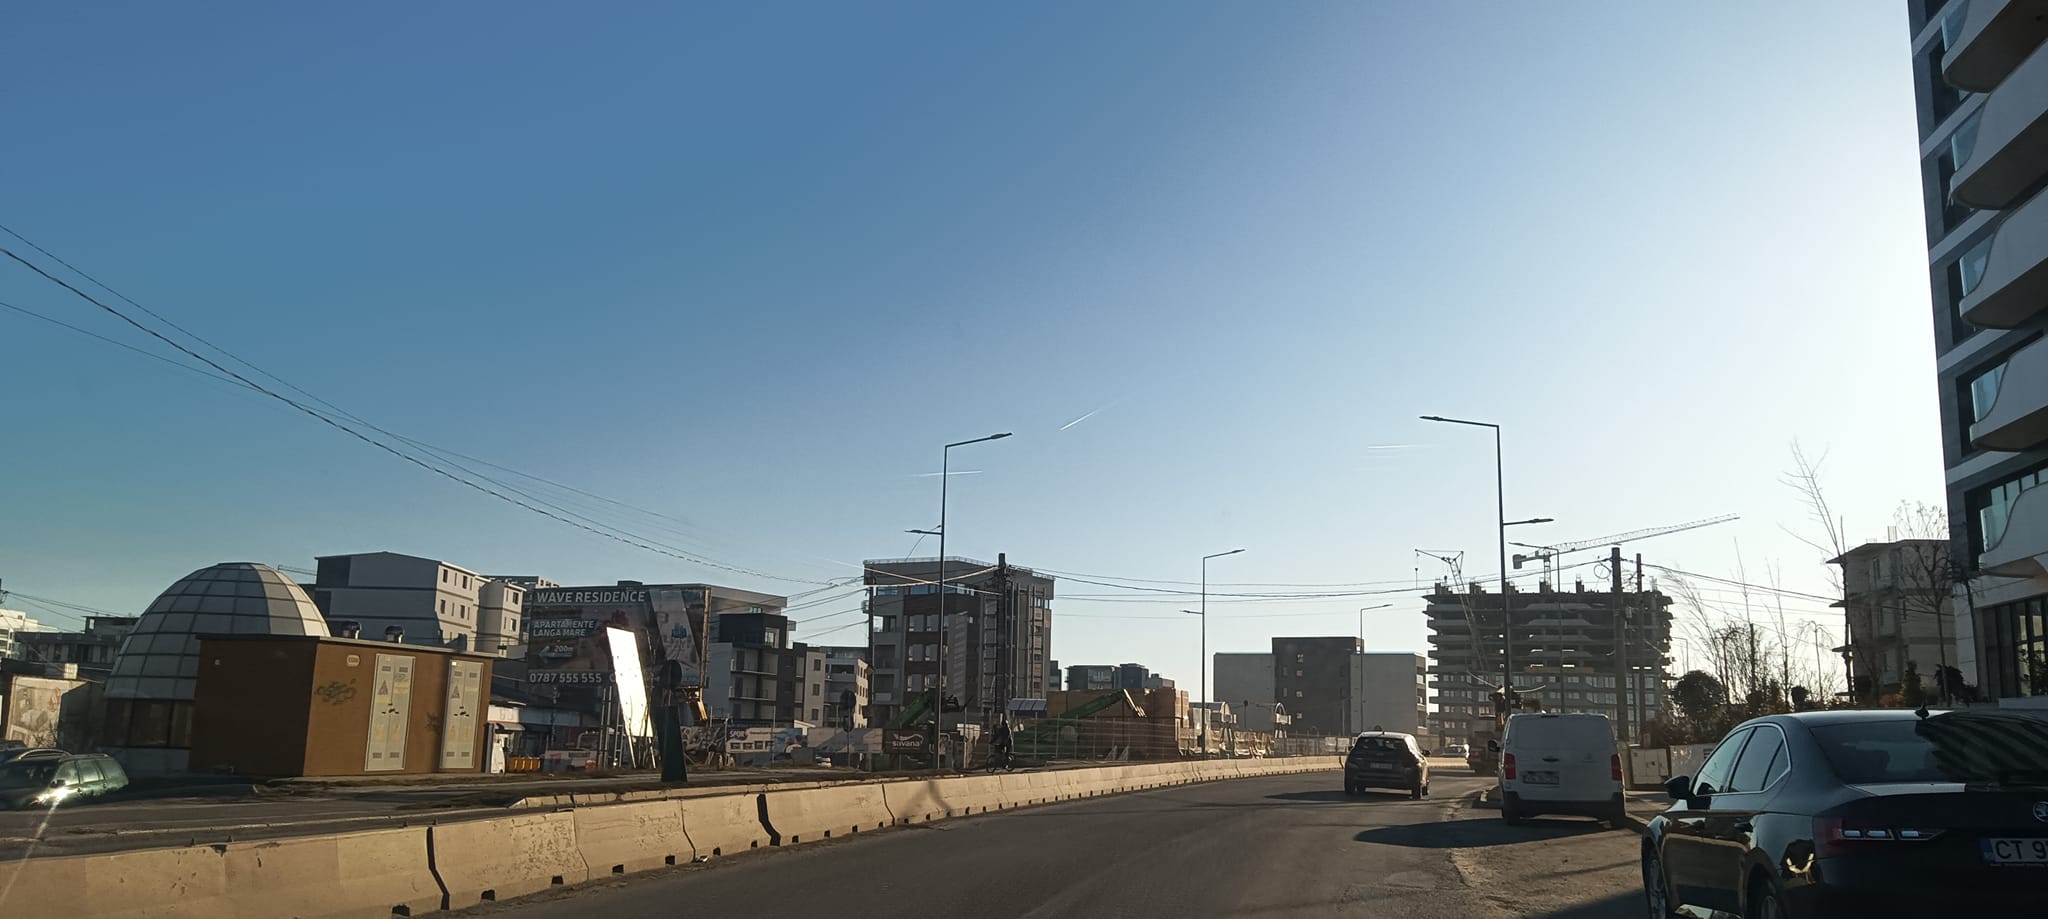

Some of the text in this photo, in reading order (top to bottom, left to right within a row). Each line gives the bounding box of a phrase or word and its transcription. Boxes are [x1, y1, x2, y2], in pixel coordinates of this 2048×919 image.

[537, 591, 646, 603] WAVE RESIDENCE
[533, 620, 594, 629] APARTAMENTE
[533, 628, 586, 637] LANGA MARE
[529, 673, 557, 683] 0787
[559, 673, 578, 683] 555
[581, 673, 602, 683] 555
[1995, 840, 2048, 860] CT 9
